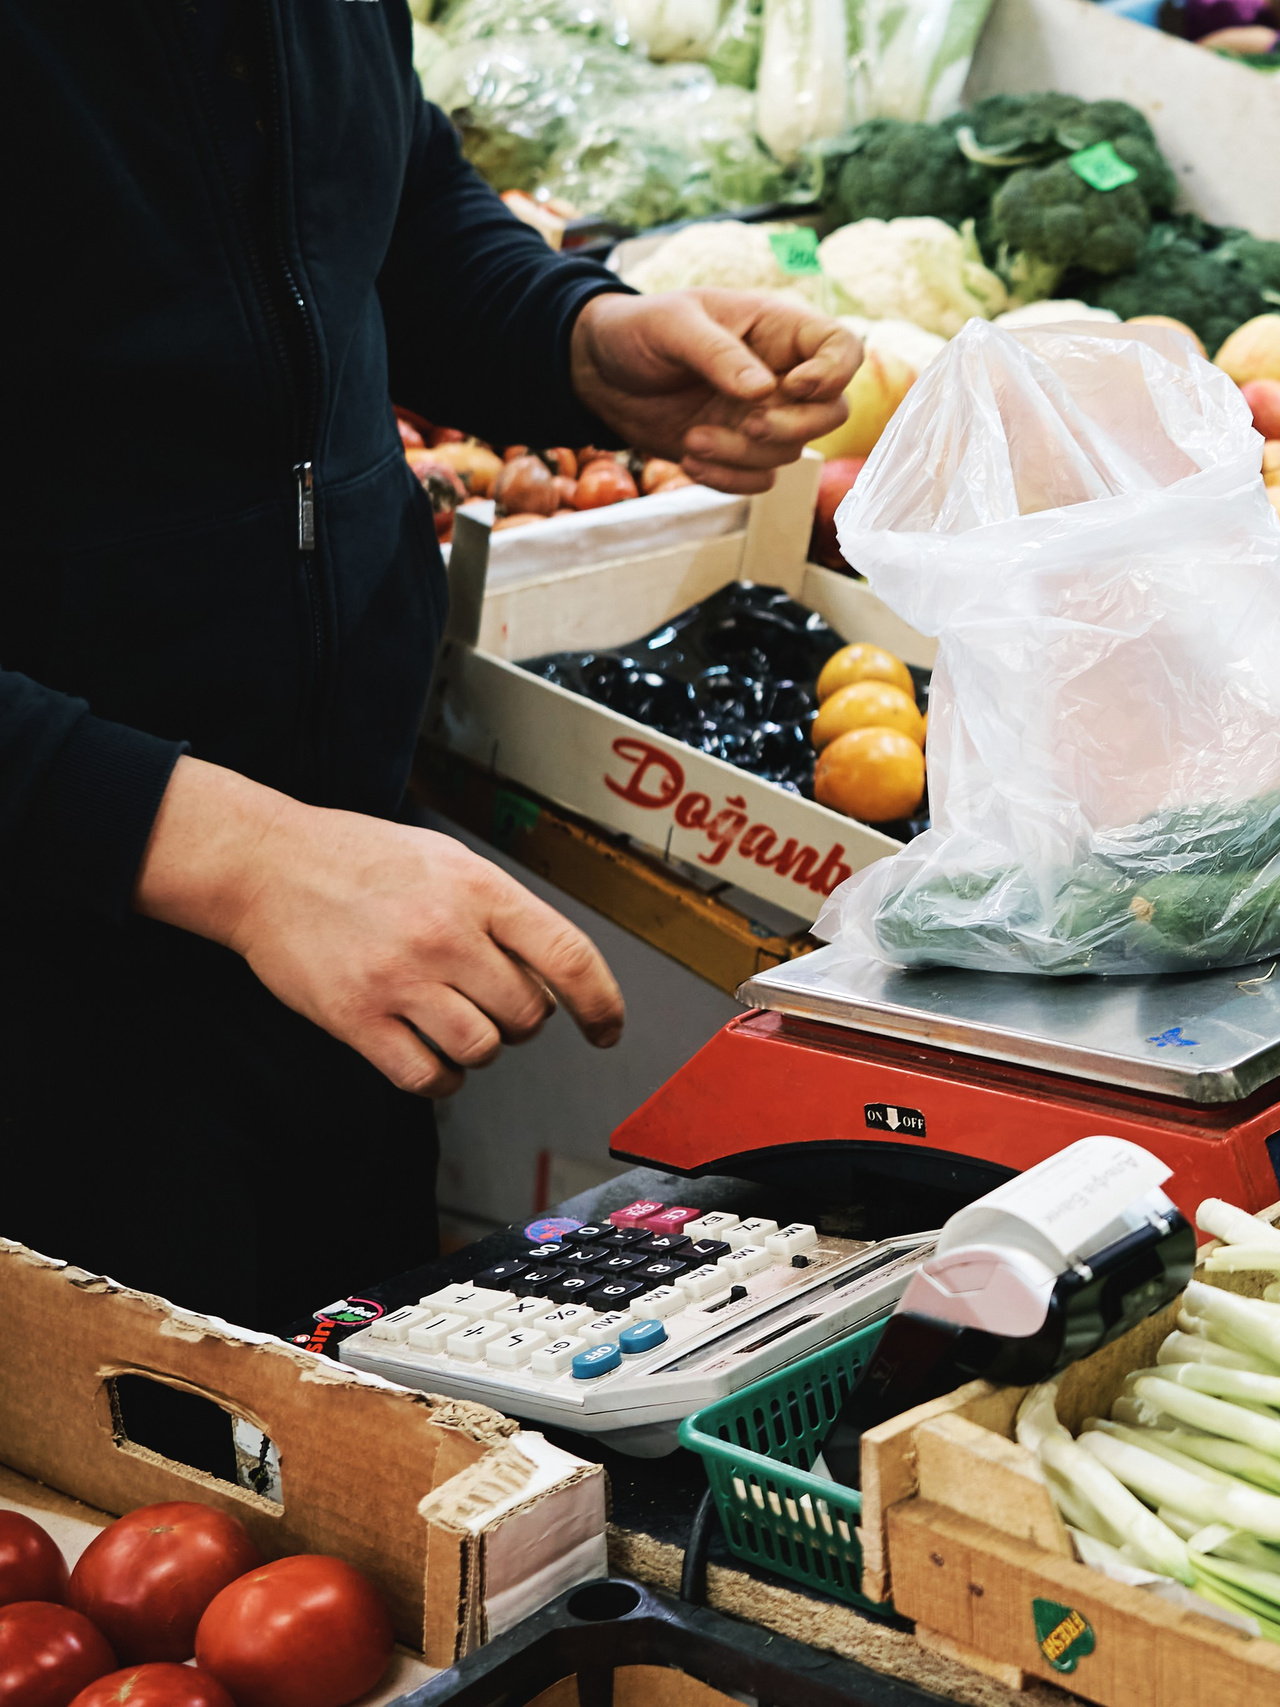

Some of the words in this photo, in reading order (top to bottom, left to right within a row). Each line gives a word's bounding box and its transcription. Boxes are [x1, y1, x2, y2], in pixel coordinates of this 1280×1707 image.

[867, 1109, 883, 1121] ON
[902, 1115, 924, 1129] OFF
[661, 1209, 687, 1220] CE
[577, 1226, 600, 1235] 0
[651, 1236, 671, 1247] 4
[528, 1244, 561, 1256] 00
[693, 1244, 714, 1254] 7
[568, 1250, 594, 1260] 2
[608, 1257, 633, 1266] 5
[646, 1263, 671, 1274] 8
[524, 1271, 548, 1281] 3
[562, 1278, 586, 1288] 6
[602, 1285, 626, 1295] 9
[544, 1308, 578, 1321] %
[583, 1346, 613, 1362] OFF
[1042, 1610, 1085, 1661] FRESH
